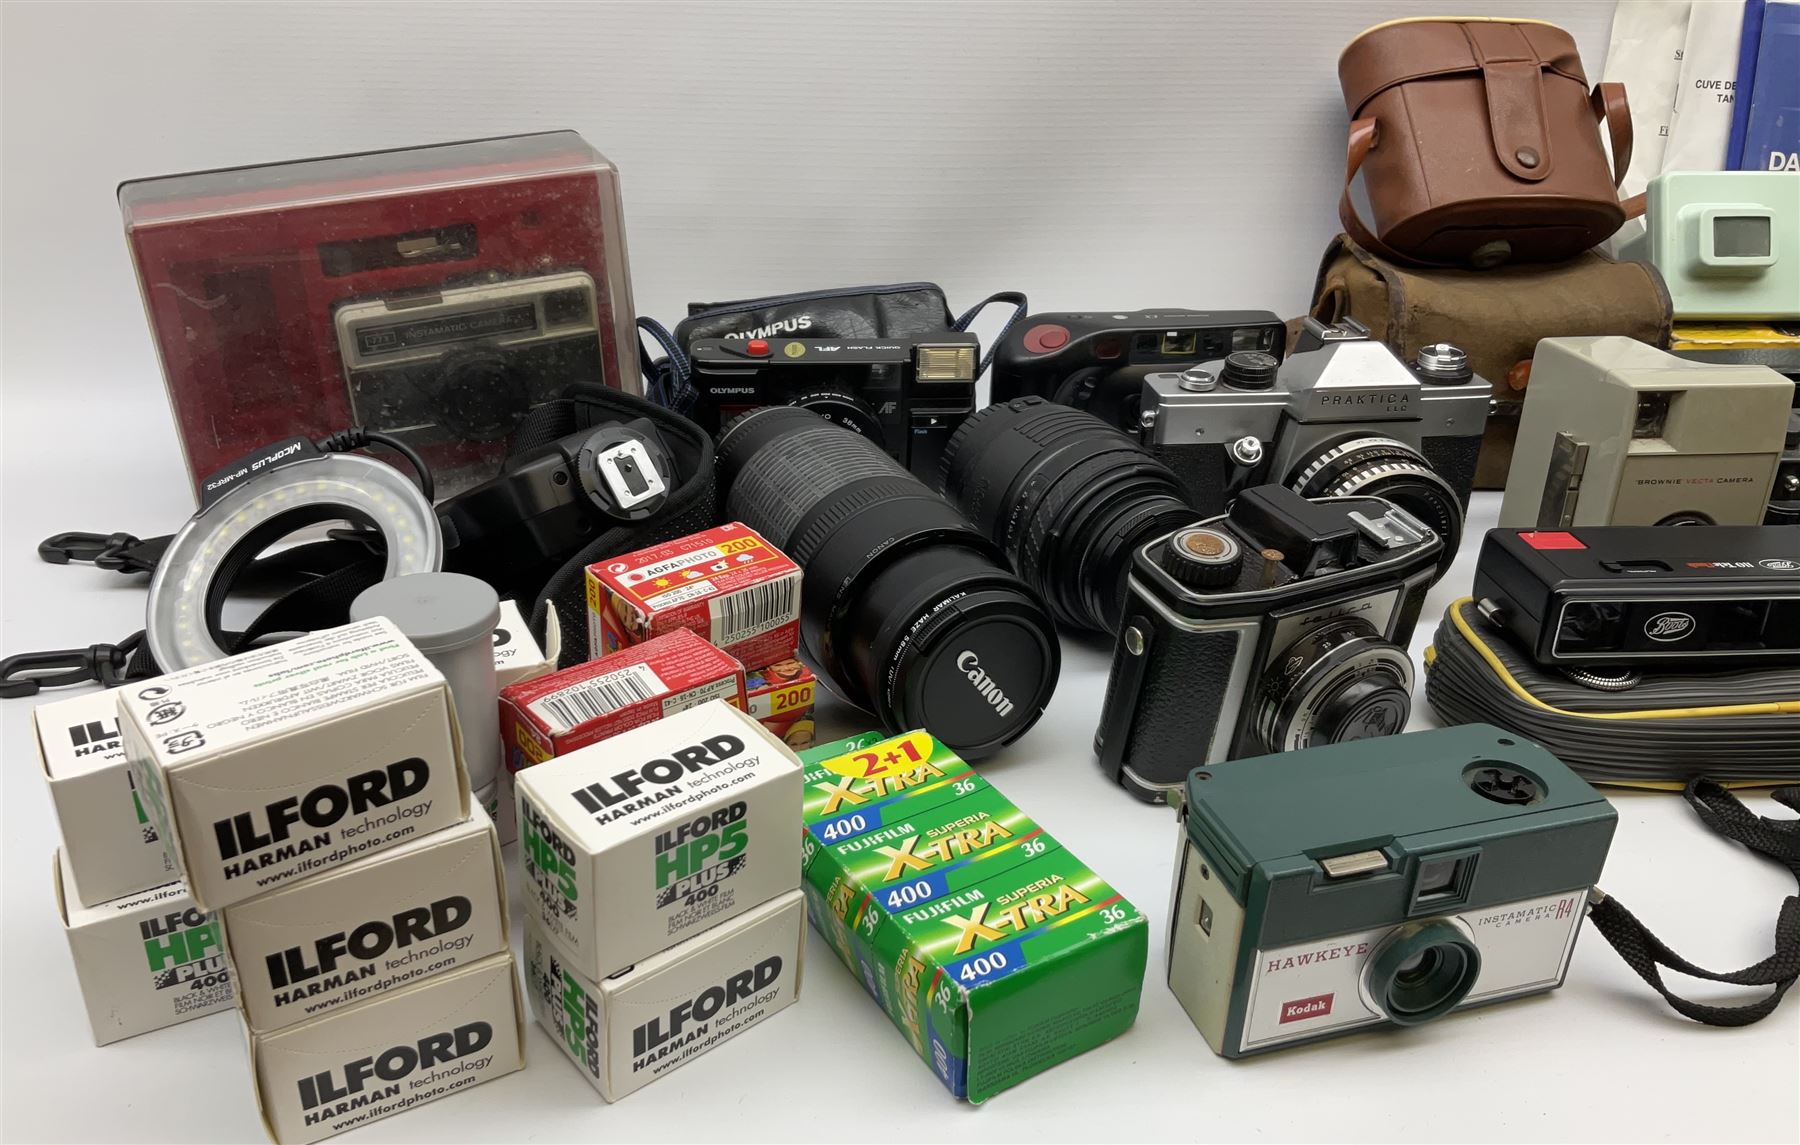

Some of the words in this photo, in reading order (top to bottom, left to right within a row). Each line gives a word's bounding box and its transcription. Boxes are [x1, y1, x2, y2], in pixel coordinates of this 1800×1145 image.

[1695, 80, 1721, 90] CUVE
[1717, 94, 1735, 104] TAN
[405, 324, 468, 340] INSTAMATIC
[469, 317, 512, 331] CAMERA
[710, 387, 755, 395] OLYMPUS
[1321, 393, 1410, 406] PRAKTICA
[878, 401, 897, 414] AF
[207, 467, 249, 491] MP-MRF32
[1685, 477, 1714, 485] VECTA
[647, 550, 718, 576] AGFAPHOTO
[721, 537, 758, 554] 200
[866, 537, 896, 560] CANON
[588, 579, 598, 608] 200
[932, 591, 967, 612] KALIMAR
[723, 627, 757, 646] 250255
[760, 613, 791, 631] 100055
[910, 613, 930, 633] HAZE
[1649, 617, 1689, 635] Boots
[407, 672, 429, 682] FILM
[584, 669, 632, 688] 250255
[699, 684, 716, 694] AP70
[956, 649, 1015, 718] Canon
[543, 682, 586, 704] 102899
[776, 687, 811, 710] 200
[205, 714, 245, 729] NEGRO
[571, 734, 745, 814] ILFORD
[853, 739, 924, 778] 2+1
[595, 785, 683, 826] HARMAN
[687, 754, 761, 788] technology
[629, 771, 756, 827] www.ilfordphoto.com
[952, 778, 976, 796] 36
[213, 756, 430, 861] ILFORD
[223, 832, 332, 880] HARMAN
[341, 800, 433, 840] technology
[522, 795, 576, 867] ILFORD
[655, 801, 747, 855] ILFORD
[823, 814, 867, 840] 400
[837, 823, 915, 855] FUJIFILM
[926, 811, 990, 838] SUPERIA
[256, 825, 416, 887] www.ilfordphoto.com
[523, 815, 578, 901] HP5
[655, 819, 748, 890] HP5
[801, 840, 815, 867] 36
[872, 819, 1015, 883] X-TRA
[1020, 839, 1046, 858] 36
[675, 861, 731, 899] PLUS
[887, 881, 932, 909] 400
[684, 884, 719, 908] 400
[902, 889, 985, 925] FUJIFILM
[996, 873, 1064, 907] SUPERIA
[140, 906, 206, 940] ILFO
[861, 906, 880, 937] 36
[941, 884, 1092, 956] X-TRA
[1099, 906, 1126, 924] 36
[1478, 904, 1558, 926] INSTAMATIC
[1555, 898, 1574, 920] R4
[1495, 913, 1552, 928] CAMERA
[144, 922, 220, 973] HP
[266, 895, 472, 990] ILFORD
[1267, 943, 1369, 973] HAWKEYE
[175, 956, 223, 982] PLU
[191, 972, 229, 990] 400
[274, 963, 376, 1007] HARMAN
[385, 933, 474, 970] technology
[960, 951, 1007, 982] 400
[304, 956, 456, 1014] www.ilfordphoto.com
[934, 980, 951, 1014] 36
[562, 969, 588, 1068] HP5
[632, 955, 783, 1058] ILFORD
[1286, 1000, 1326, 1017] Kodak
[585, 992, 600, 1080] ILFORD
[633, 1023, 709, 1073] HARMAN
[715, 986, 780, 1028] technology
[652, 1007, 765, 1075] www.ilfordphoto.com
[297, 1021, 493, 1111] ILFORD
[304, 1083, 401, 1126] HARMAN
[408, 1055, 494, 1090] technology
[332, 1074, 476, 1131] www.ilfordphoto.com
